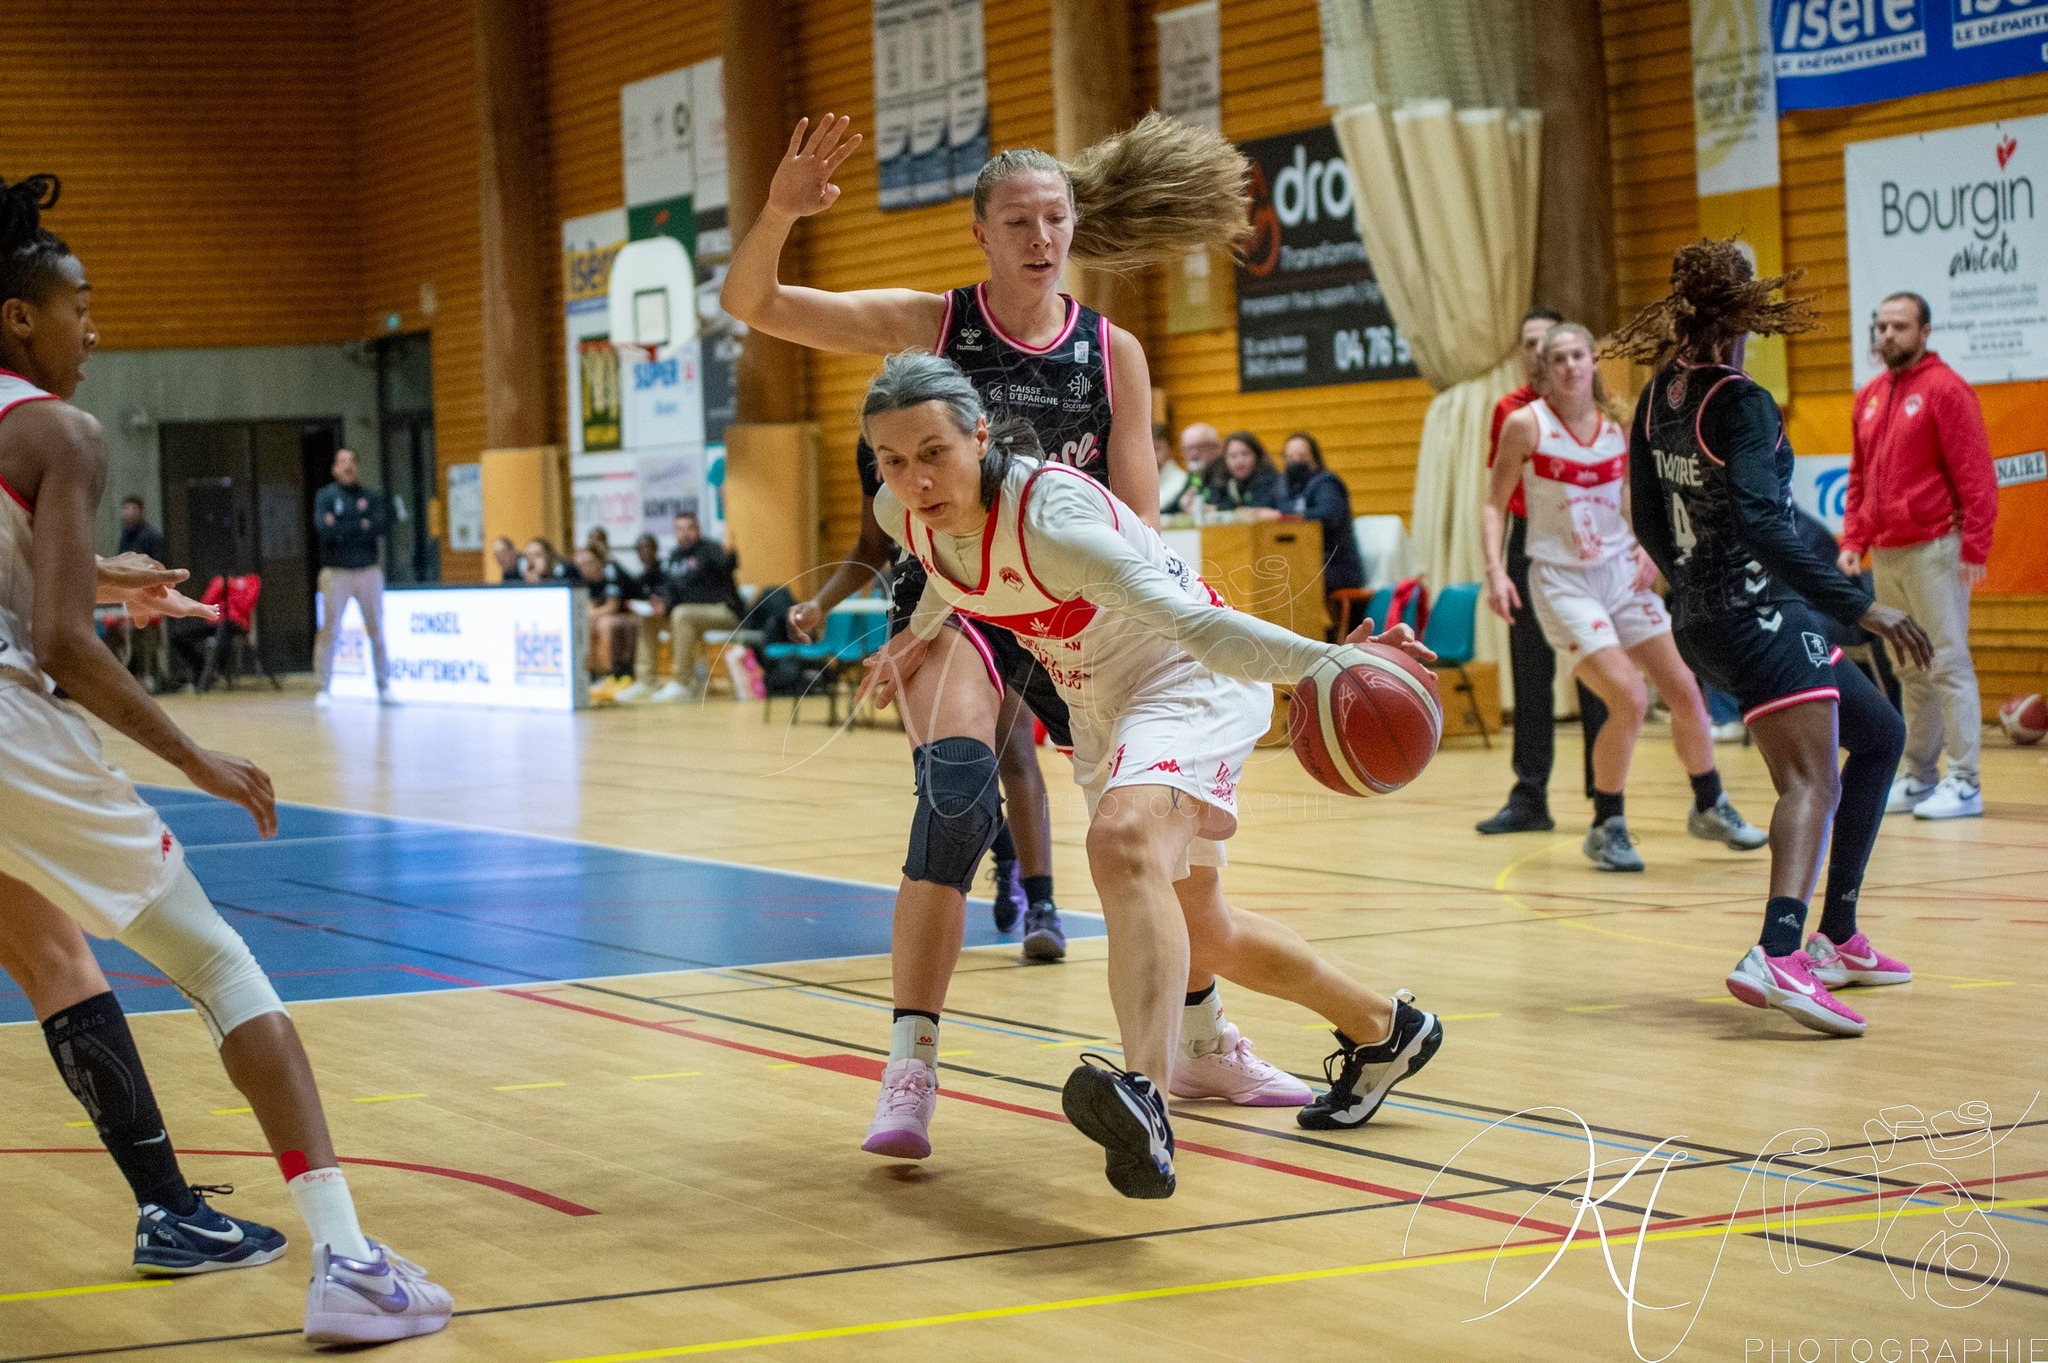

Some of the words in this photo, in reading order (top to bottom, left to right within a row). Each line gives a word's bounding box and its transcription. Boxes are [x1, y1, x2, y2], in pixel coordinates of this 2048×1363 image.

[1881, 176, 2034, 241] Bourgin
[956, 343, 983, 351] hummel
[1009, 384, 1041, 395] CAISSE
[1009, 392, 1059, 406] D'EPARGNE
